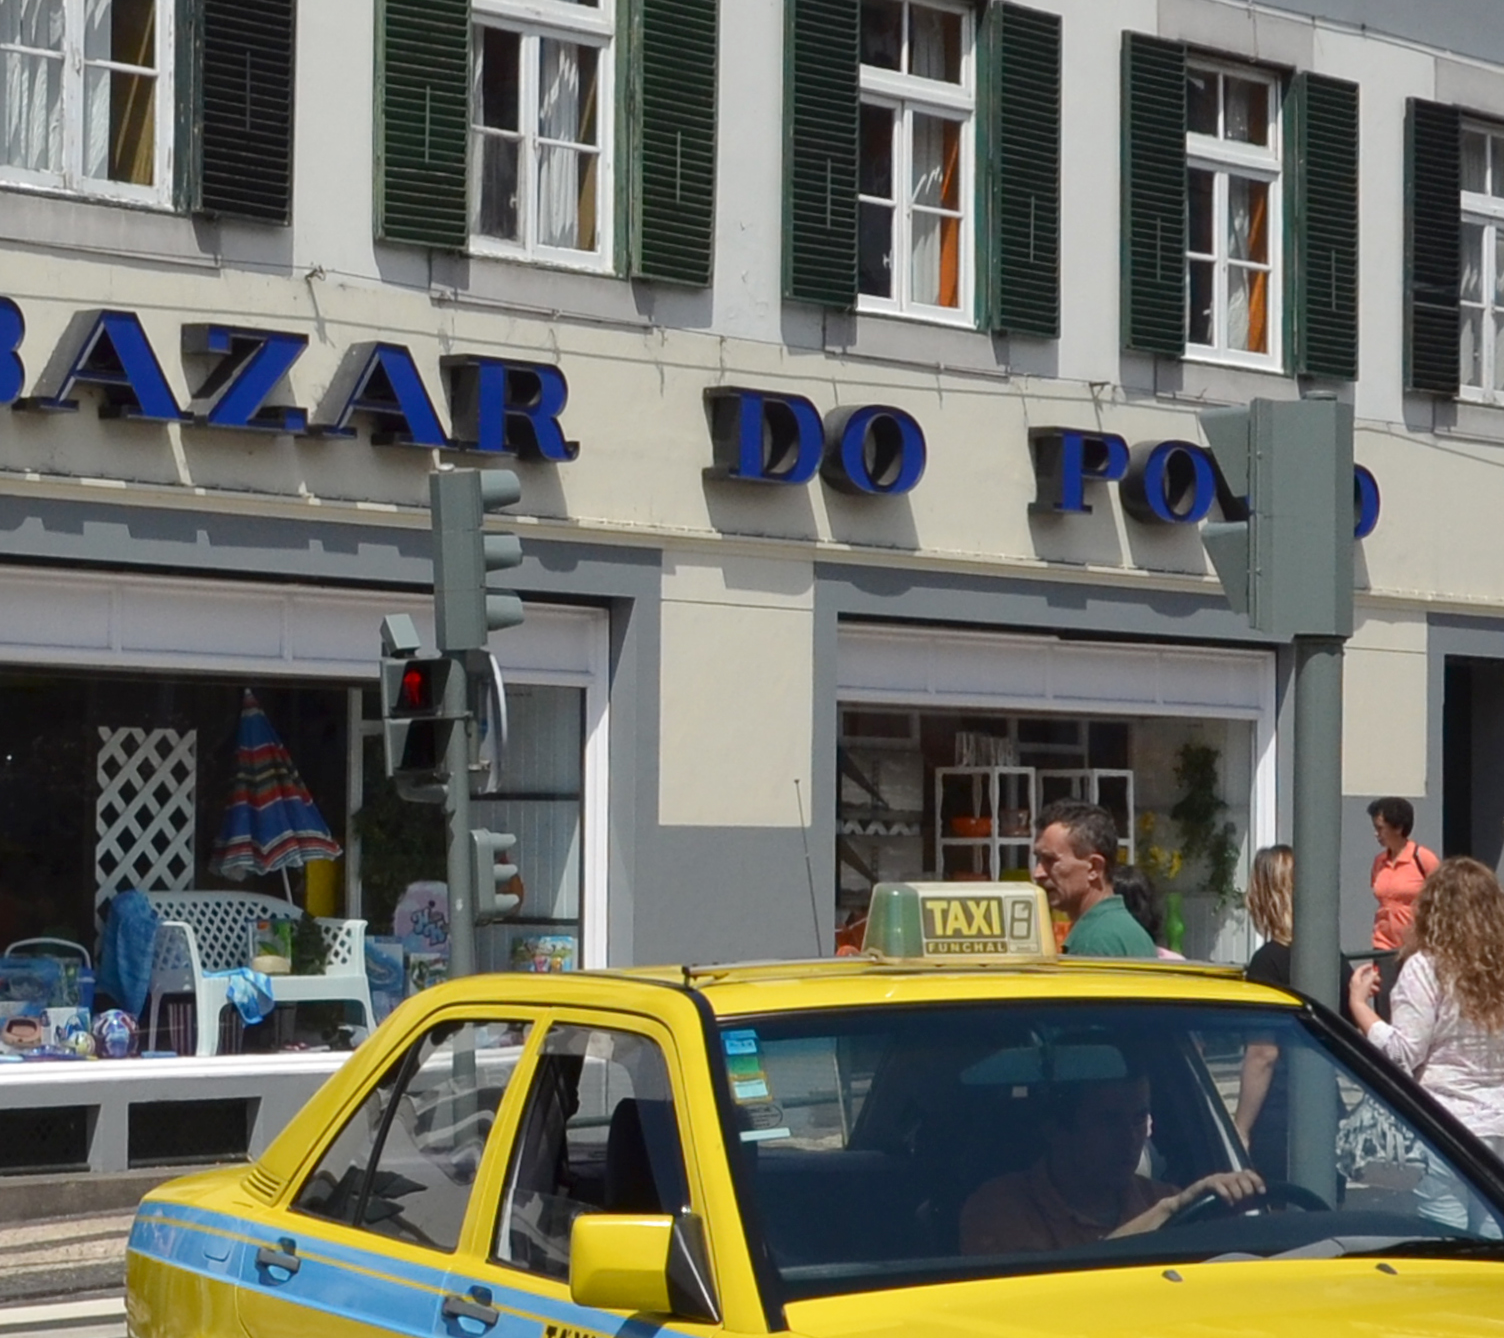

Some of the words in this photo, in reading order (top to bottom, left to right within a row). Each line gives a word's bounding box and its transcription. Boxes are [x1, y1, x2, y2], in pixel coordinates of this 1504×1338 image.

[702, 385, 927, 498] DO
[1028, 426, 1381, 541] PO
[925, 899, 1002, 936] TAXI
[927, 942, 1006, 953] FUNCHAL
